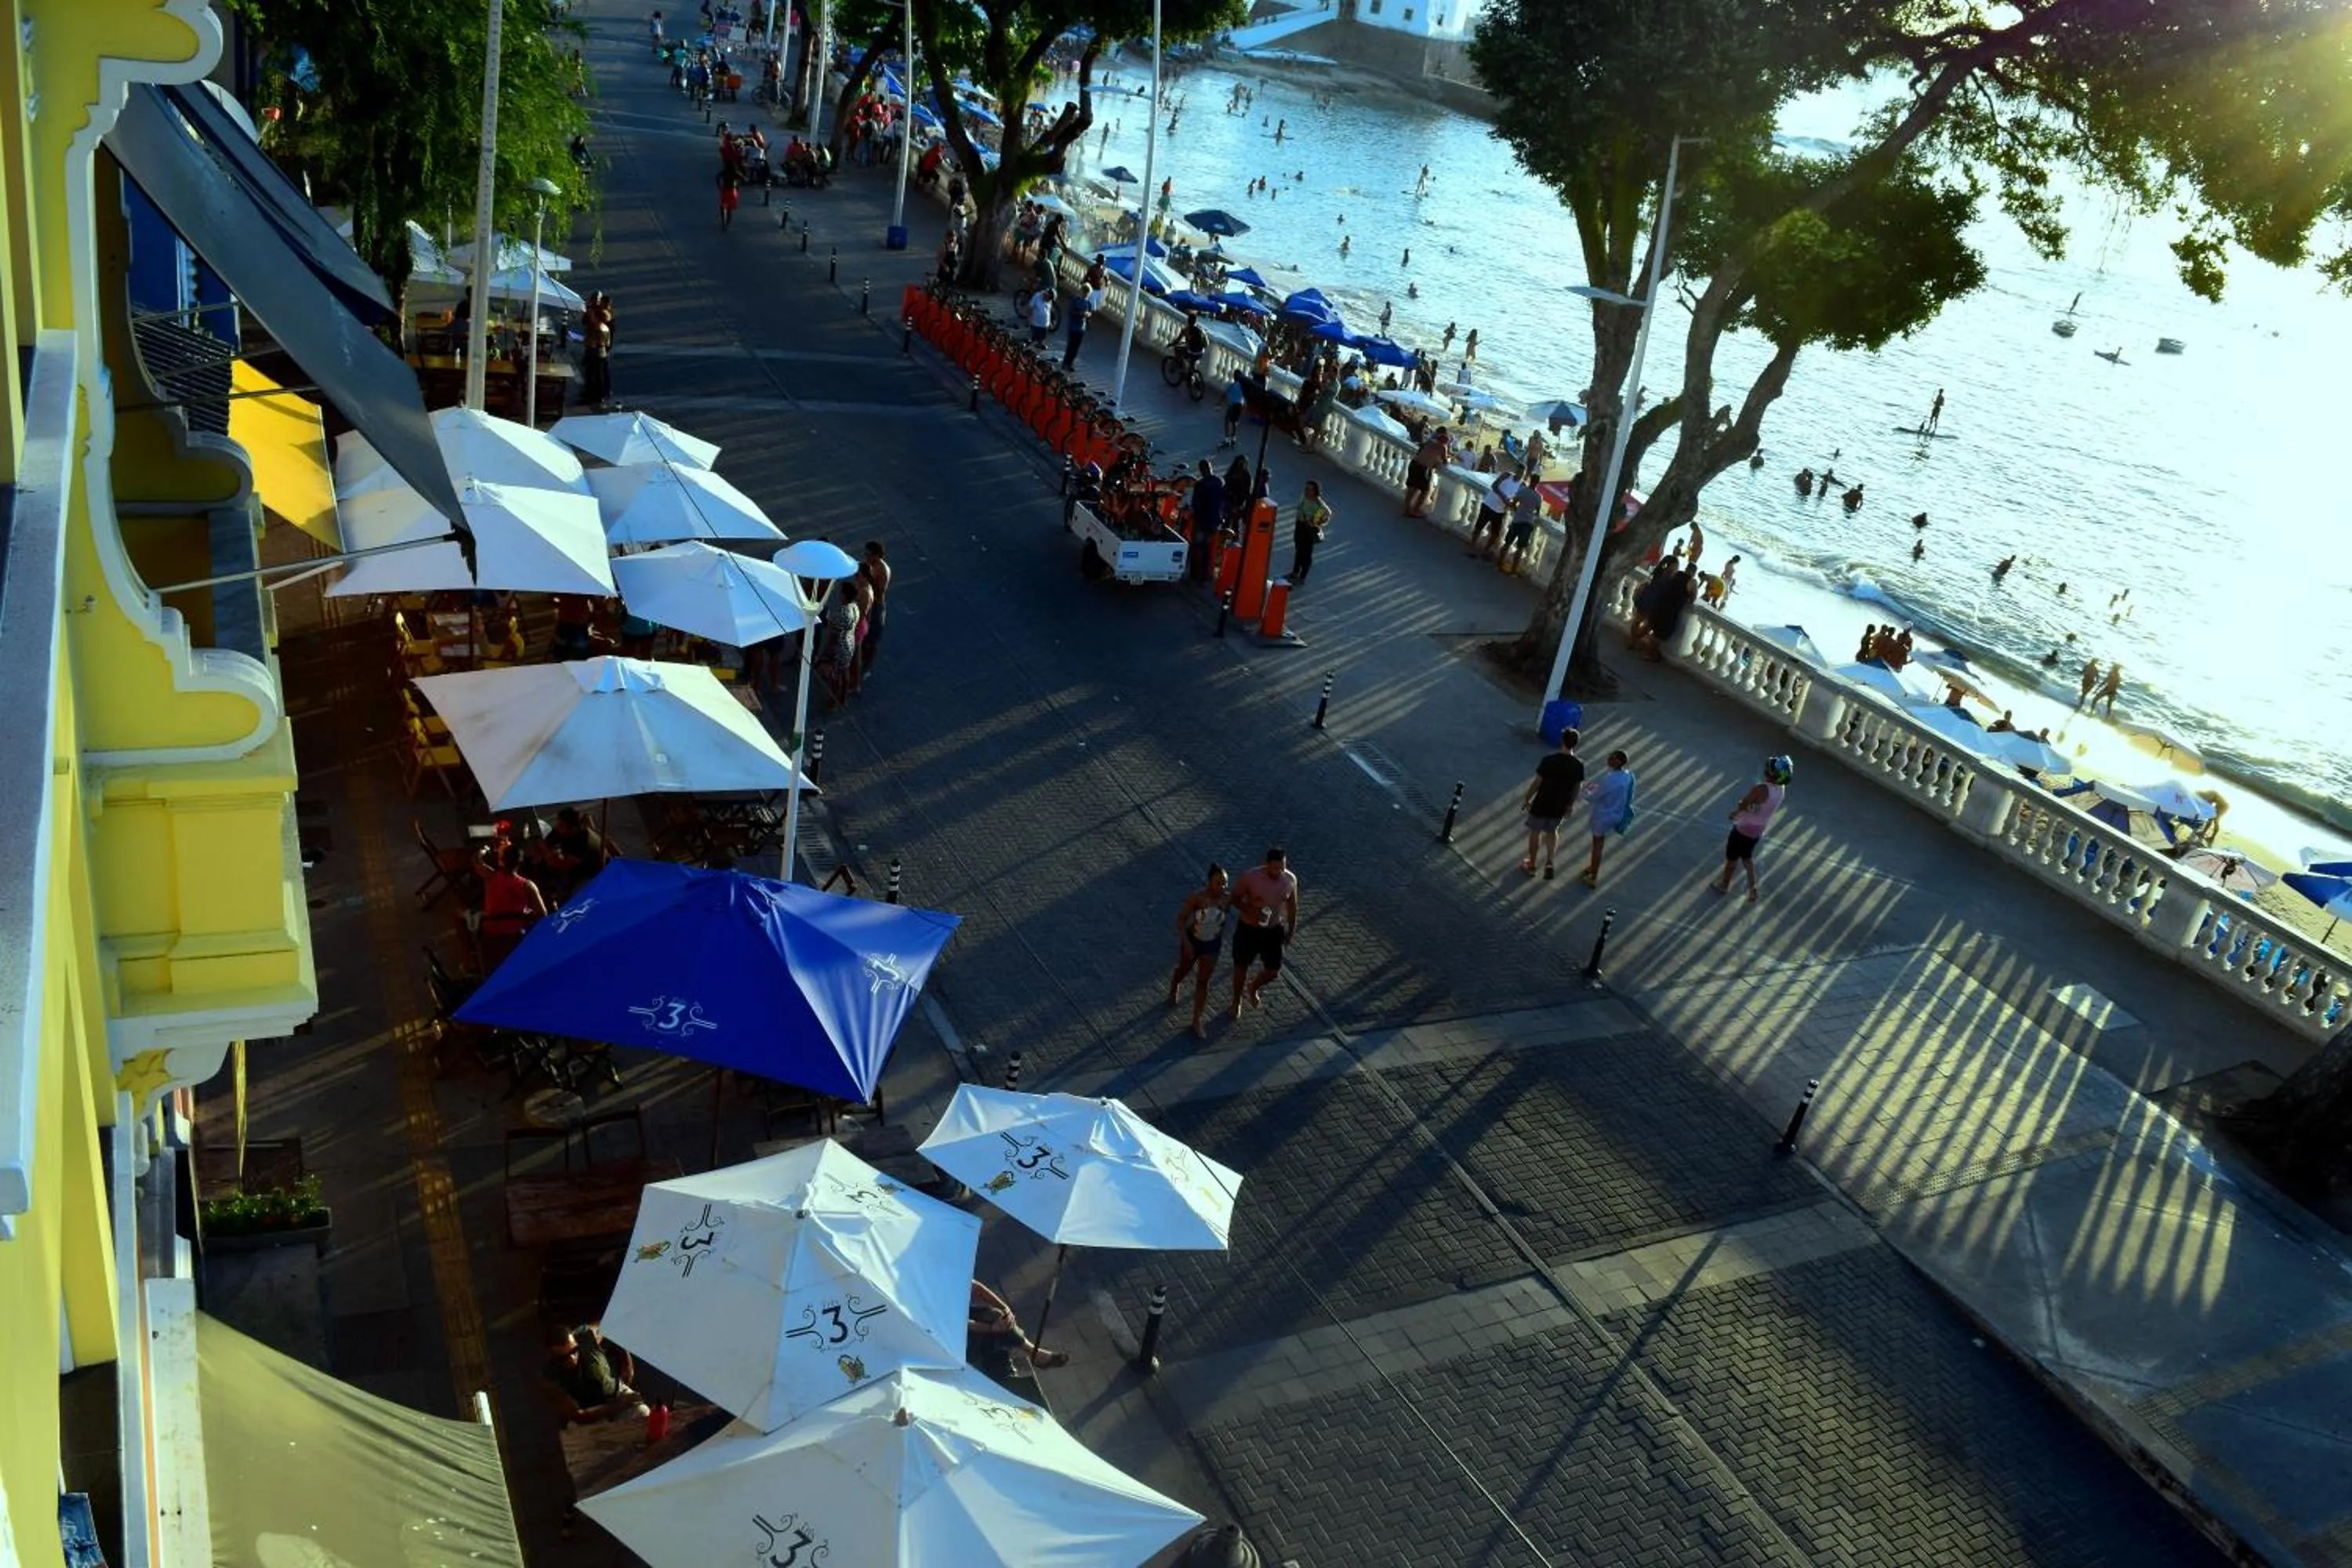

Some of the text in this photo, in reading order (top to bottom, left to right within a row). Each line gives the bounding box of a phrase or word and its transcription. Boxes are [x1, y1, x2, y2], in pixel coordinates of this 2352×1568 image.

[659, 1002, 686, 1029] 3
[1017, 1146, 1051, 1168] 3
[681, 1232, 715, 1250] 3
[822, 1305, 848, 1343] 3
[770, 1527, 813, 1568] 3
